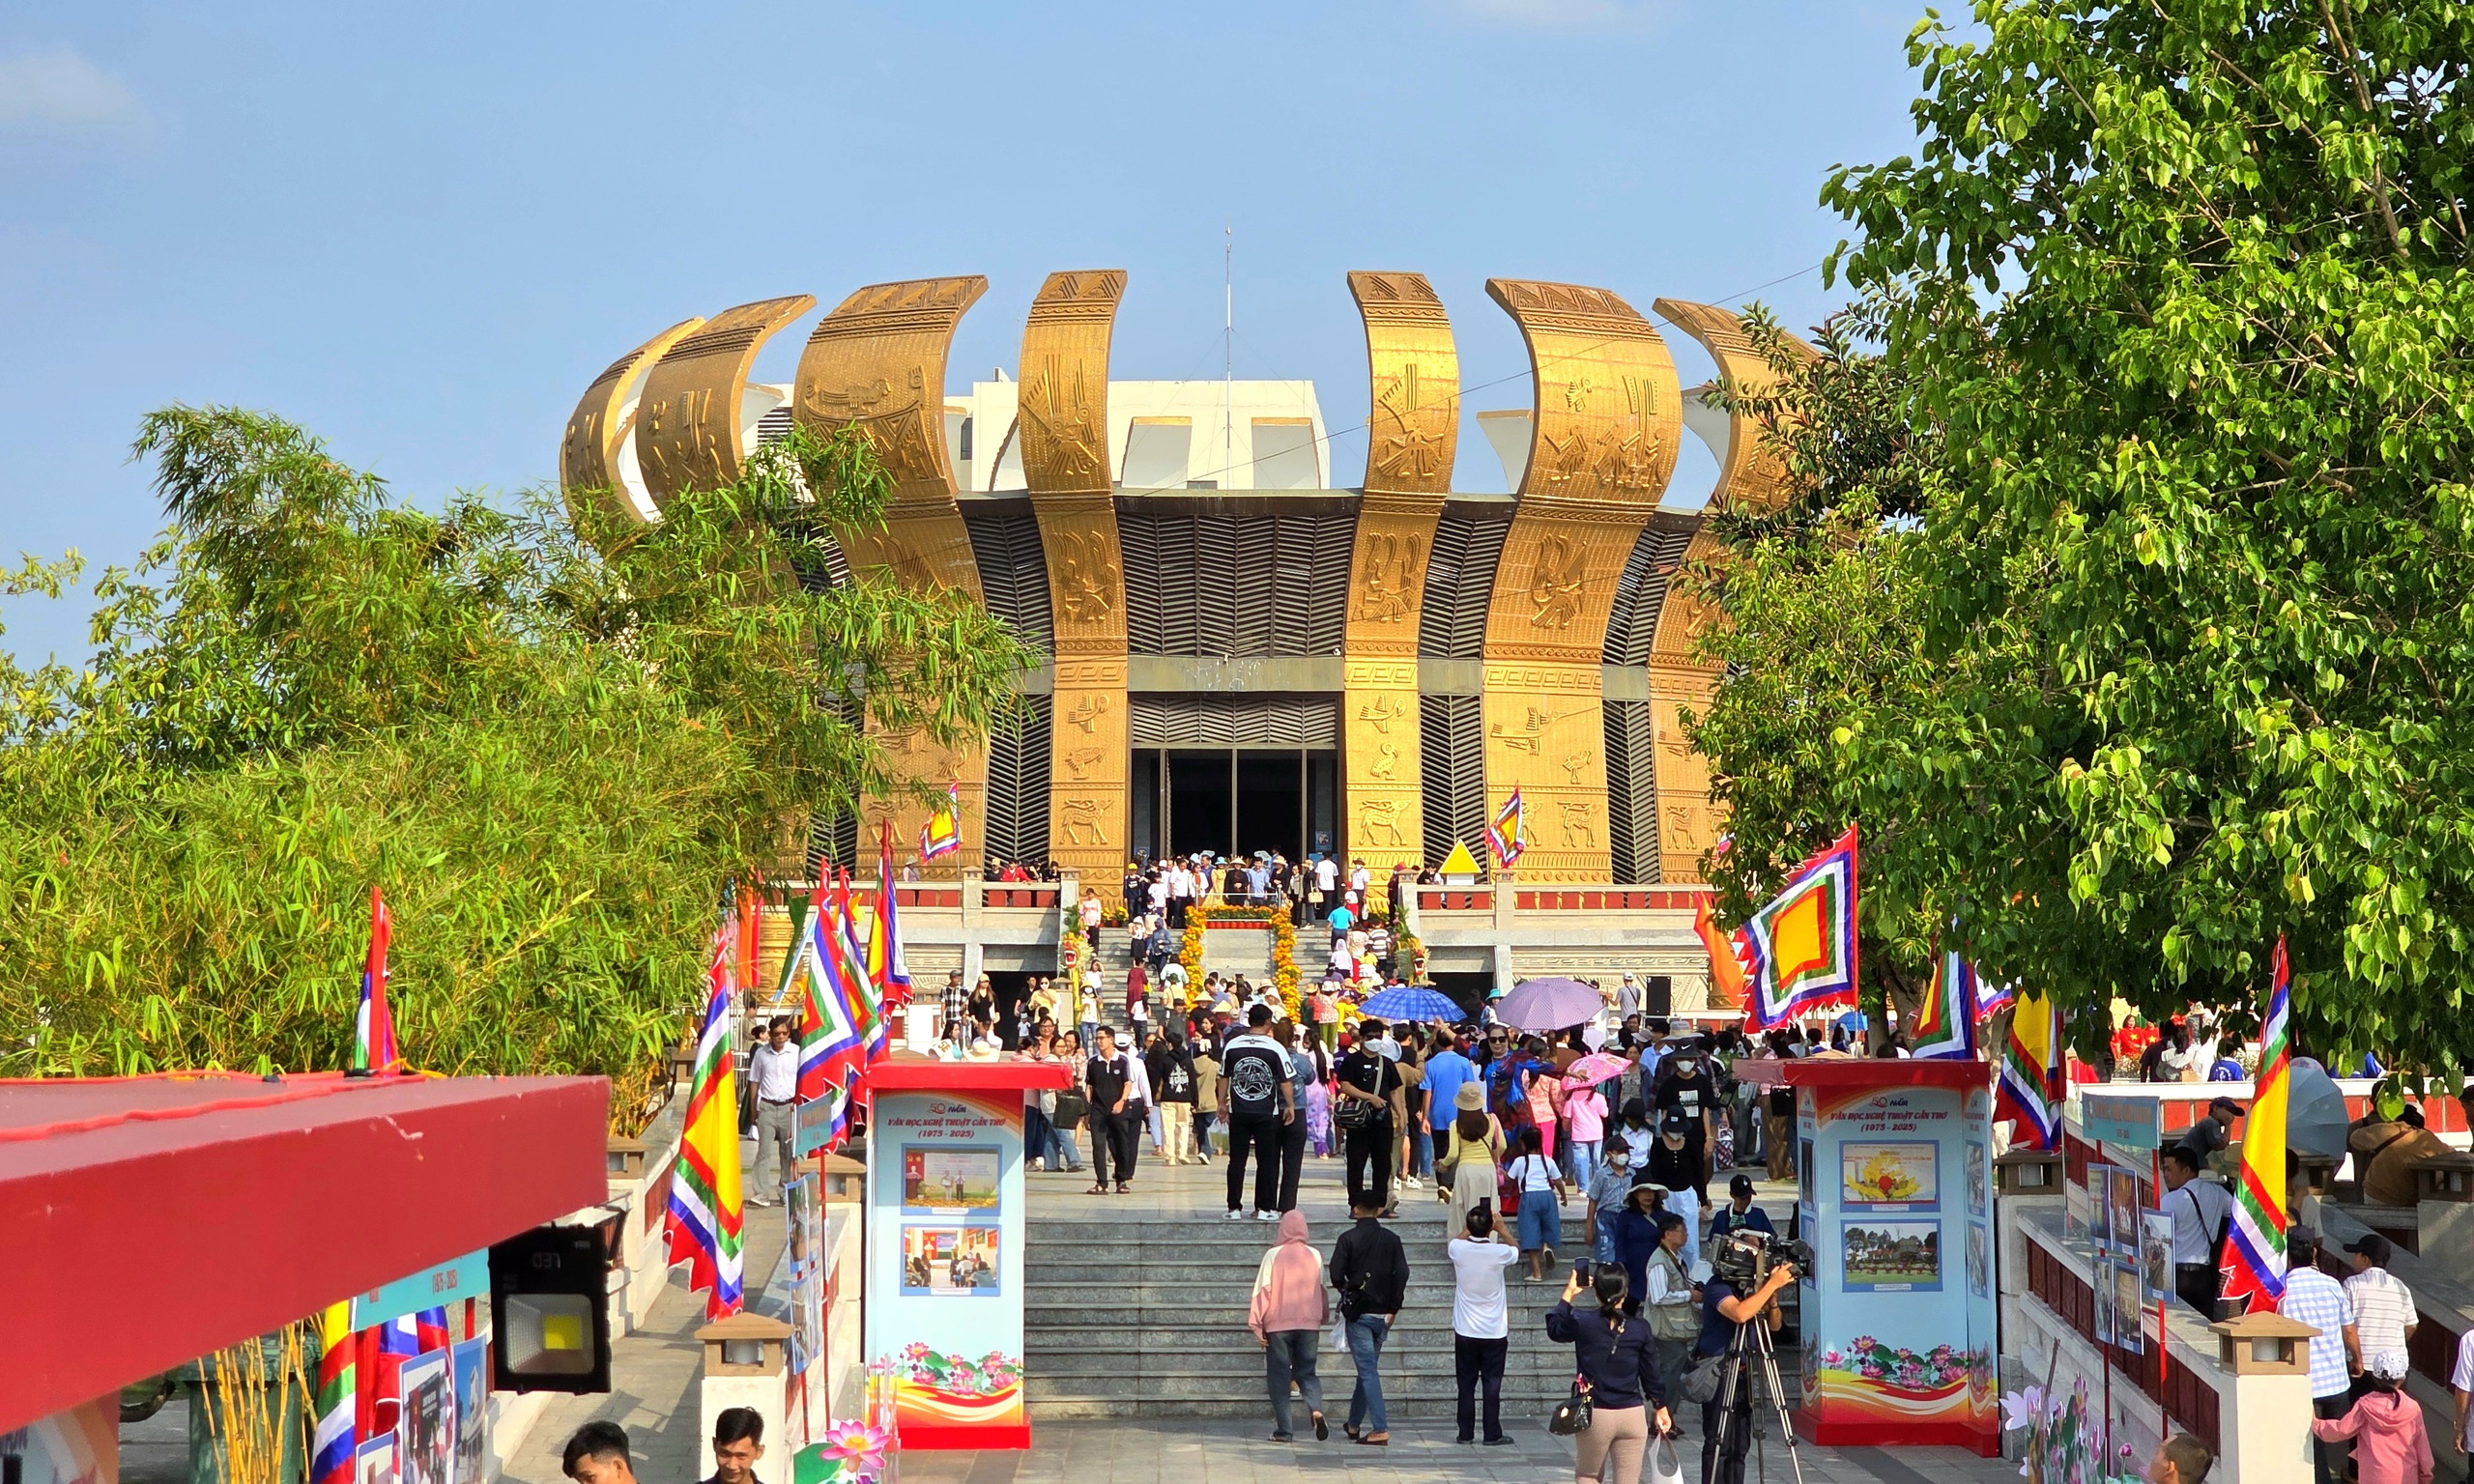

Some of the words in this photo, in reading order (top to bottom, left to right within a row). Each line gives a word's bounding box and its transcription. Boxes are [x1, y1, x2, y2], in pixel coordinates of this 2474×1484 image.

[929, 1102, 946, 1114] 50
[1865, 1111, 1885, 1121] NGHỆ
[1887, 1111, 1913, 1121] THUẬT
[1913, 1109, 1930, 1119] CẦN
[923, 1117, 943, 1127] NGHỆ
[945, 1118, 971, 1127] THUẬT
[972, 1116, 988, 1126] CẦN
[1860, 1124, 1885, 1132] (1975
[1891, 1124, 1917, 1132] 2025)
[918, 1130, 943, 1139] (1975
[949, 1129, 974, 1139] 2025)
